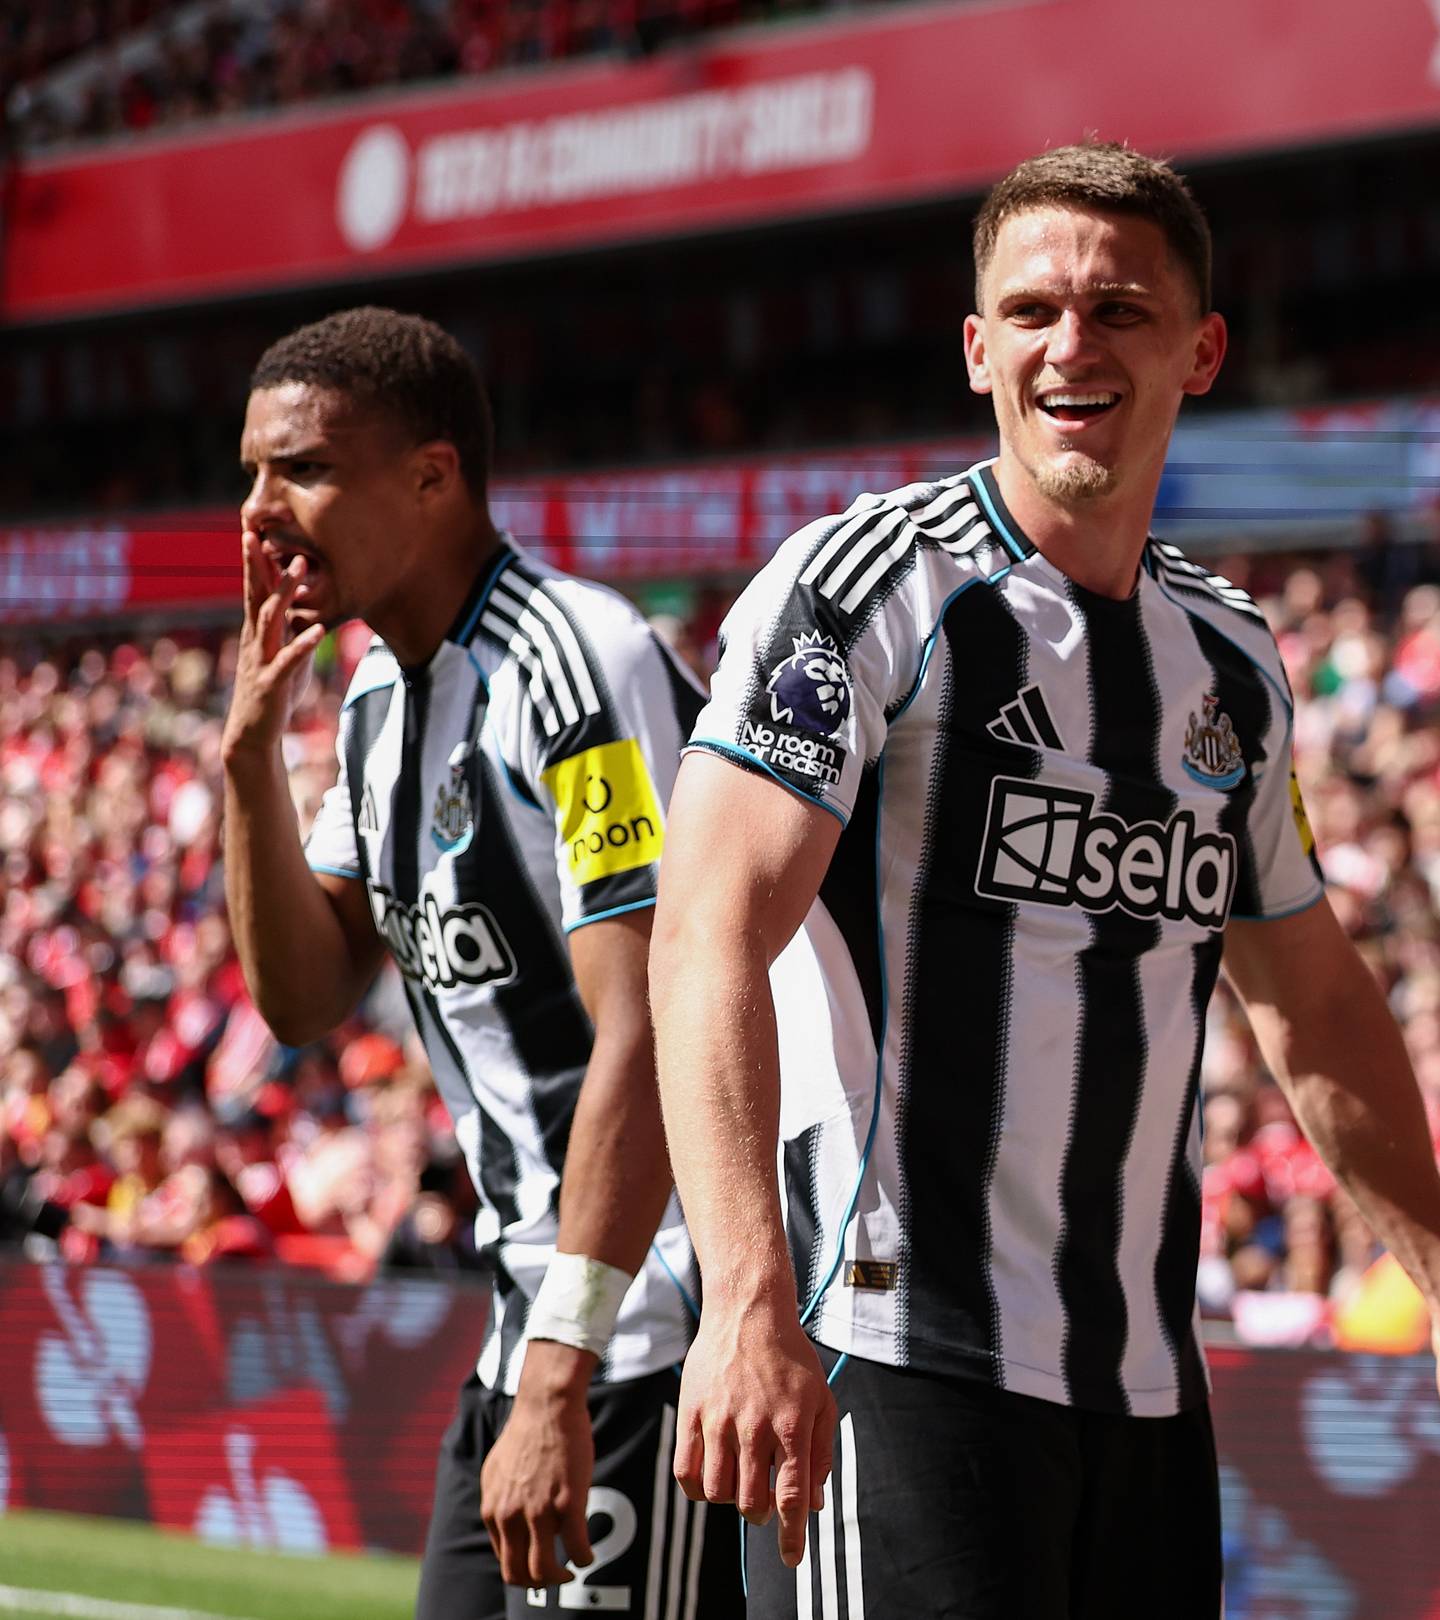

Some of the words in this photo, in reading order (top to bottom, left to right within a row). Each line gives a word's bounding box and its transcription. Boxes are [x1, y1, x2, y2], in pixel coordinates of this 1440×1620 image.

[736, 64, 873, 173] SHIELD
[740, 721, 775, 746] No
[776, 733, 835, 765] room
[770, 748, 840, 784] racism
[573, 816, 654, 861] noon
[1076, 820, 1230, 917] sela
